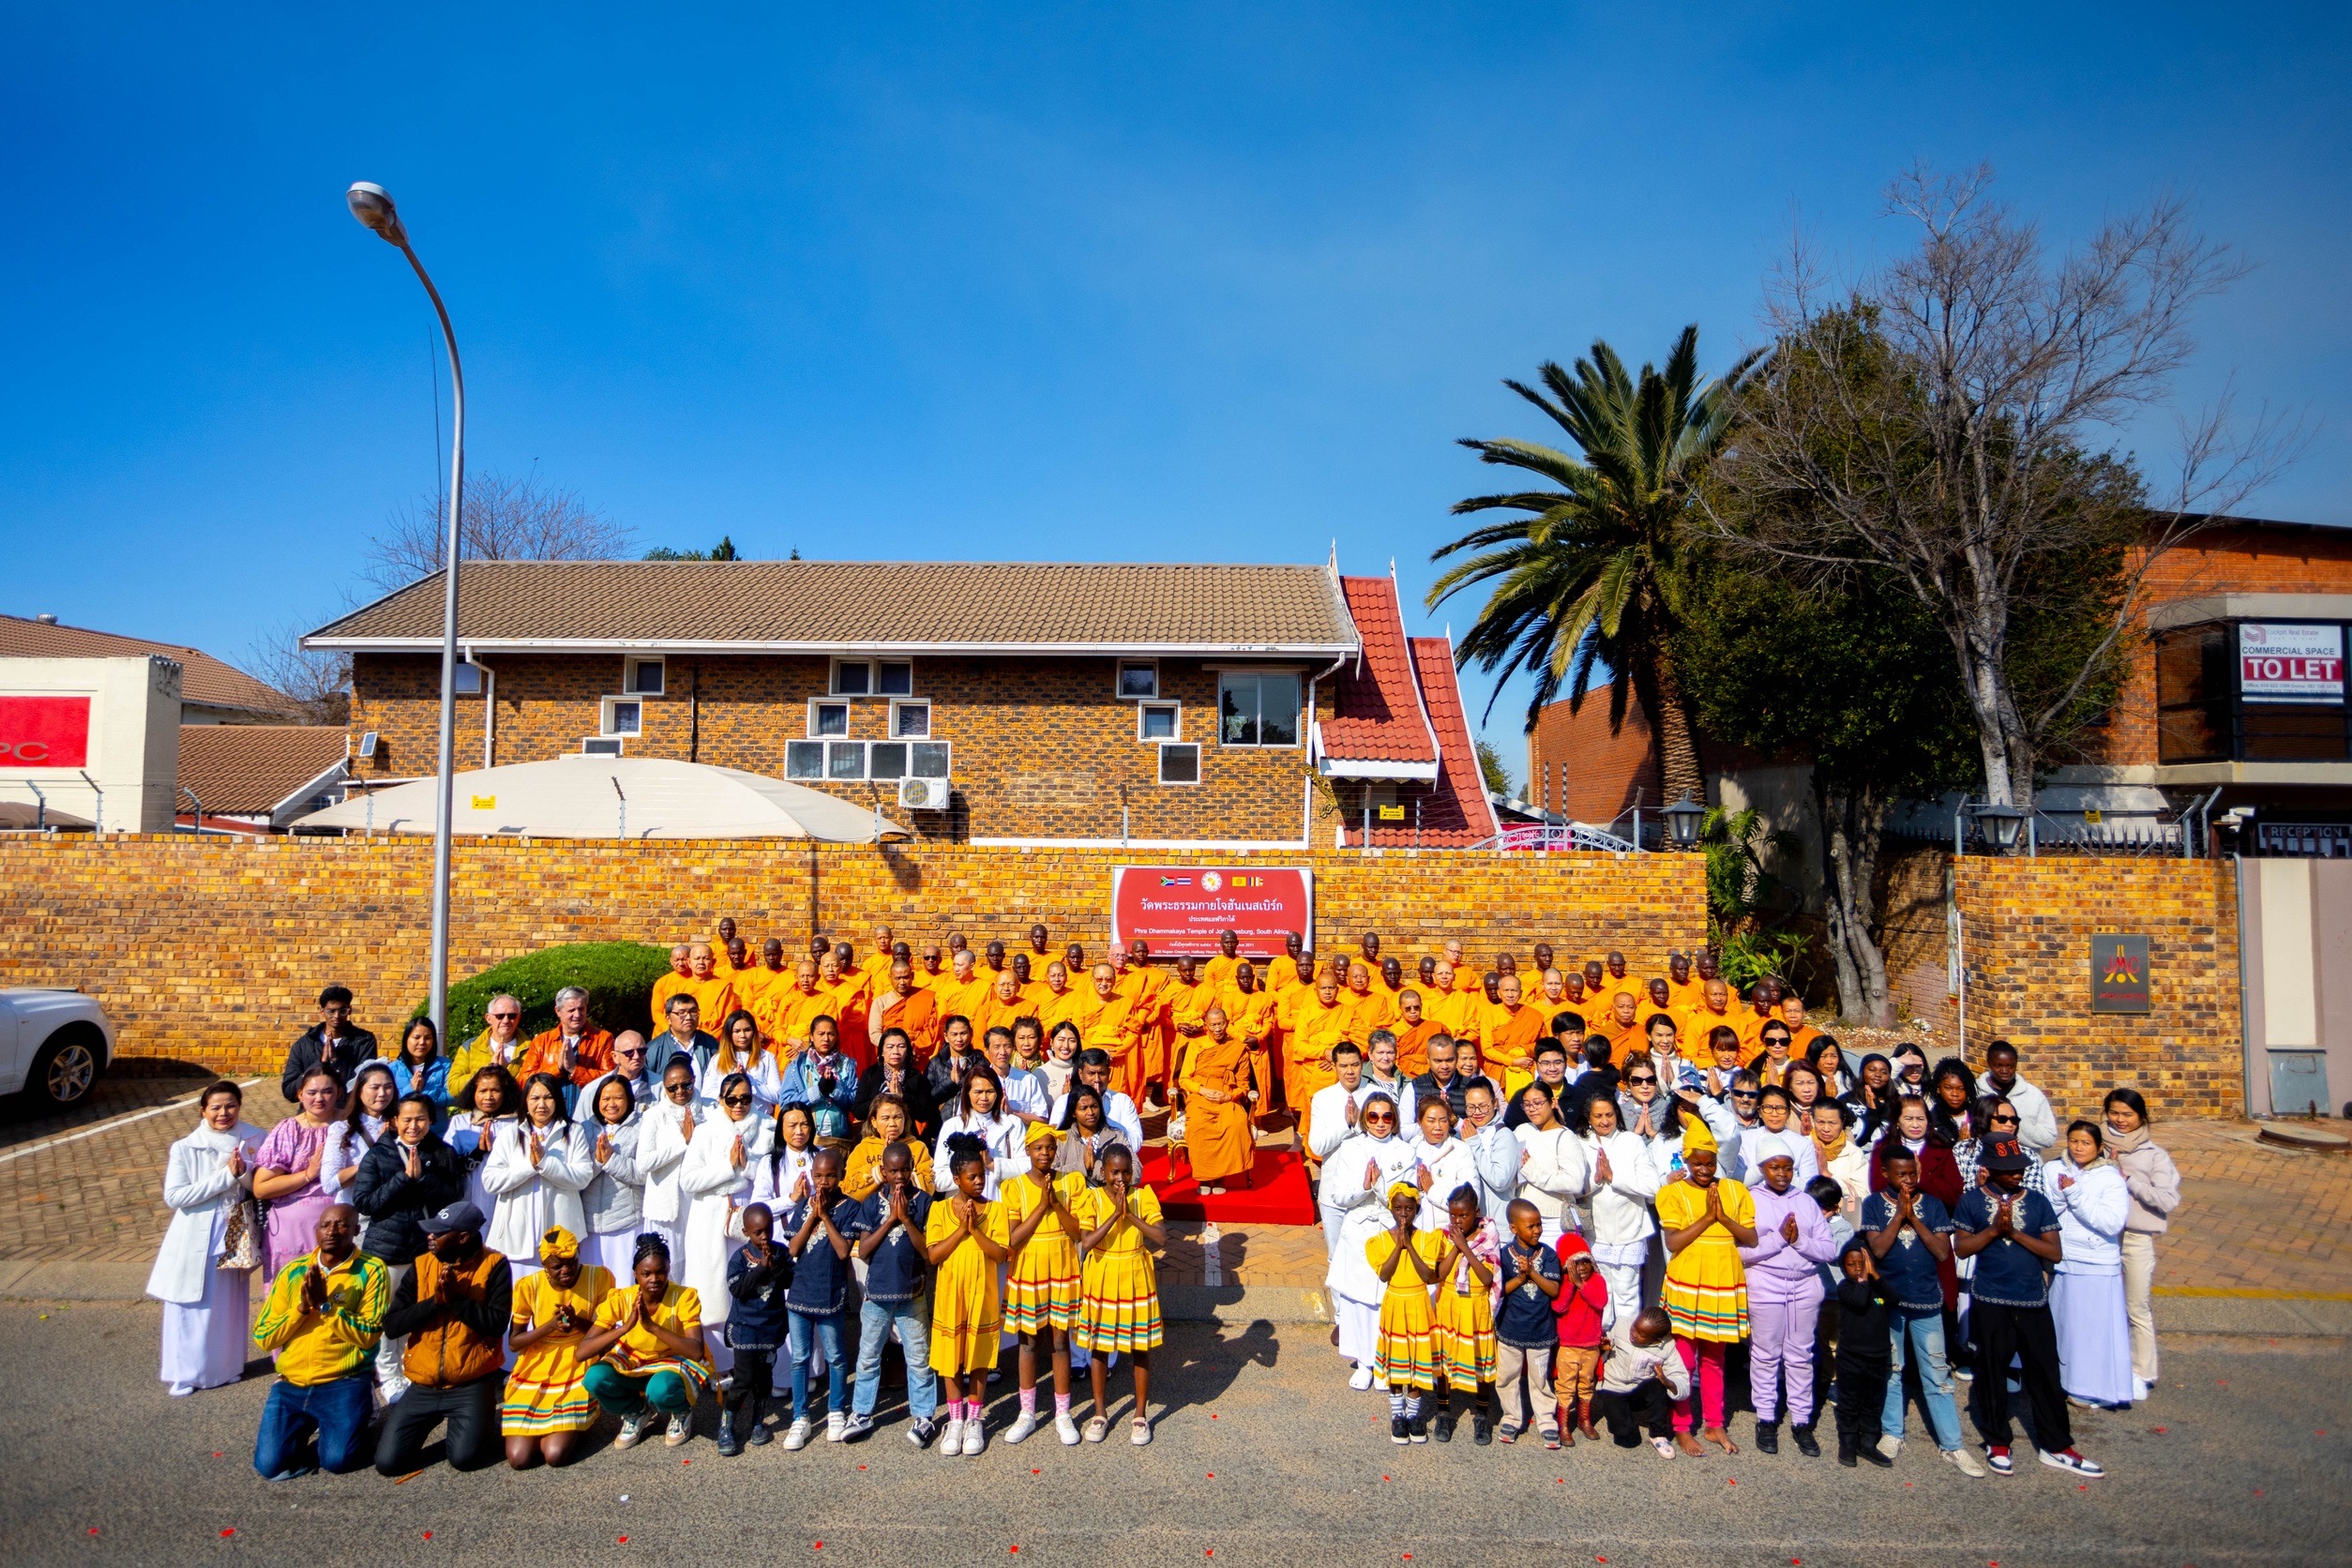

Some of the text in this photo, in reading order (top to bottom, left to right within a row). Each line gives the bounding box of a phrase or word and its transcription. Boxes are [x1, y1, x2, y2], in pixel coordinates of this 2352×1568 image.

[2241, 646, 2335, 656] COMMERCIAL SPACE
[2248, 658, 2337, 680] TO LET
[2103, 955, 2140, 973] JMC
